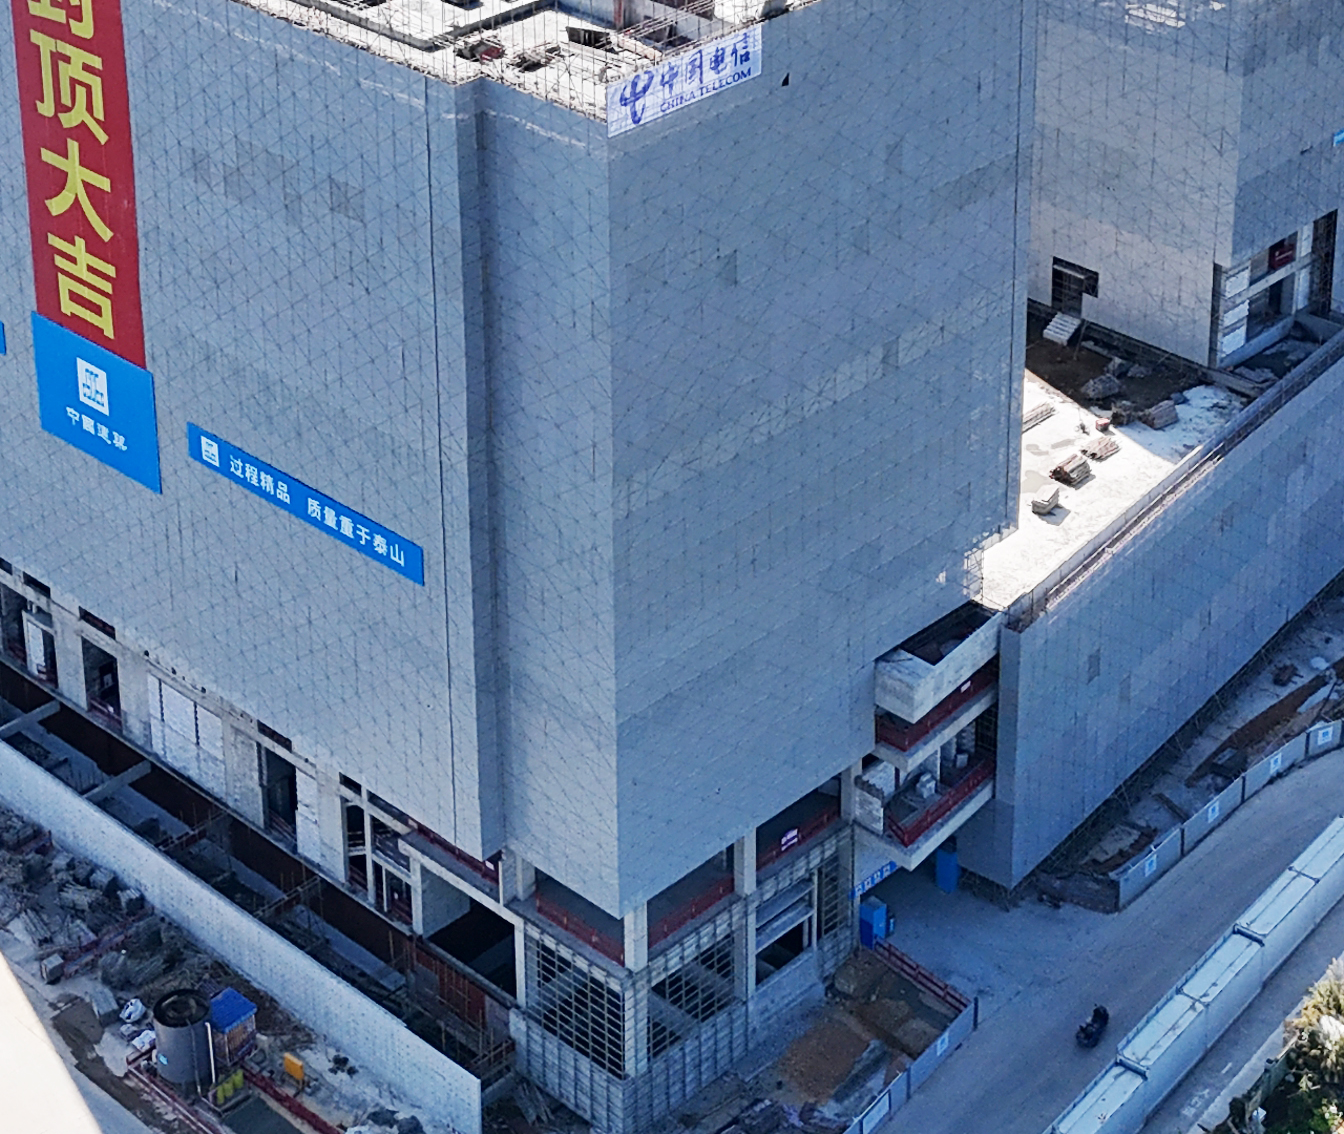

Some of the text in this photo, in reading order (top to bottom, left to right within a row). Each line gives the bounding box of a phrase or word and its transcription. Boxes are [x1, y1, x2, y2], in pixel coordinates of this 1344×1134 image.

[660, 32, 751, 95] 中国电信
[660, 67, 752, 113] CHINA TELECOM
[229, 454, 405, 567] 过程精品 质量重于泰山
